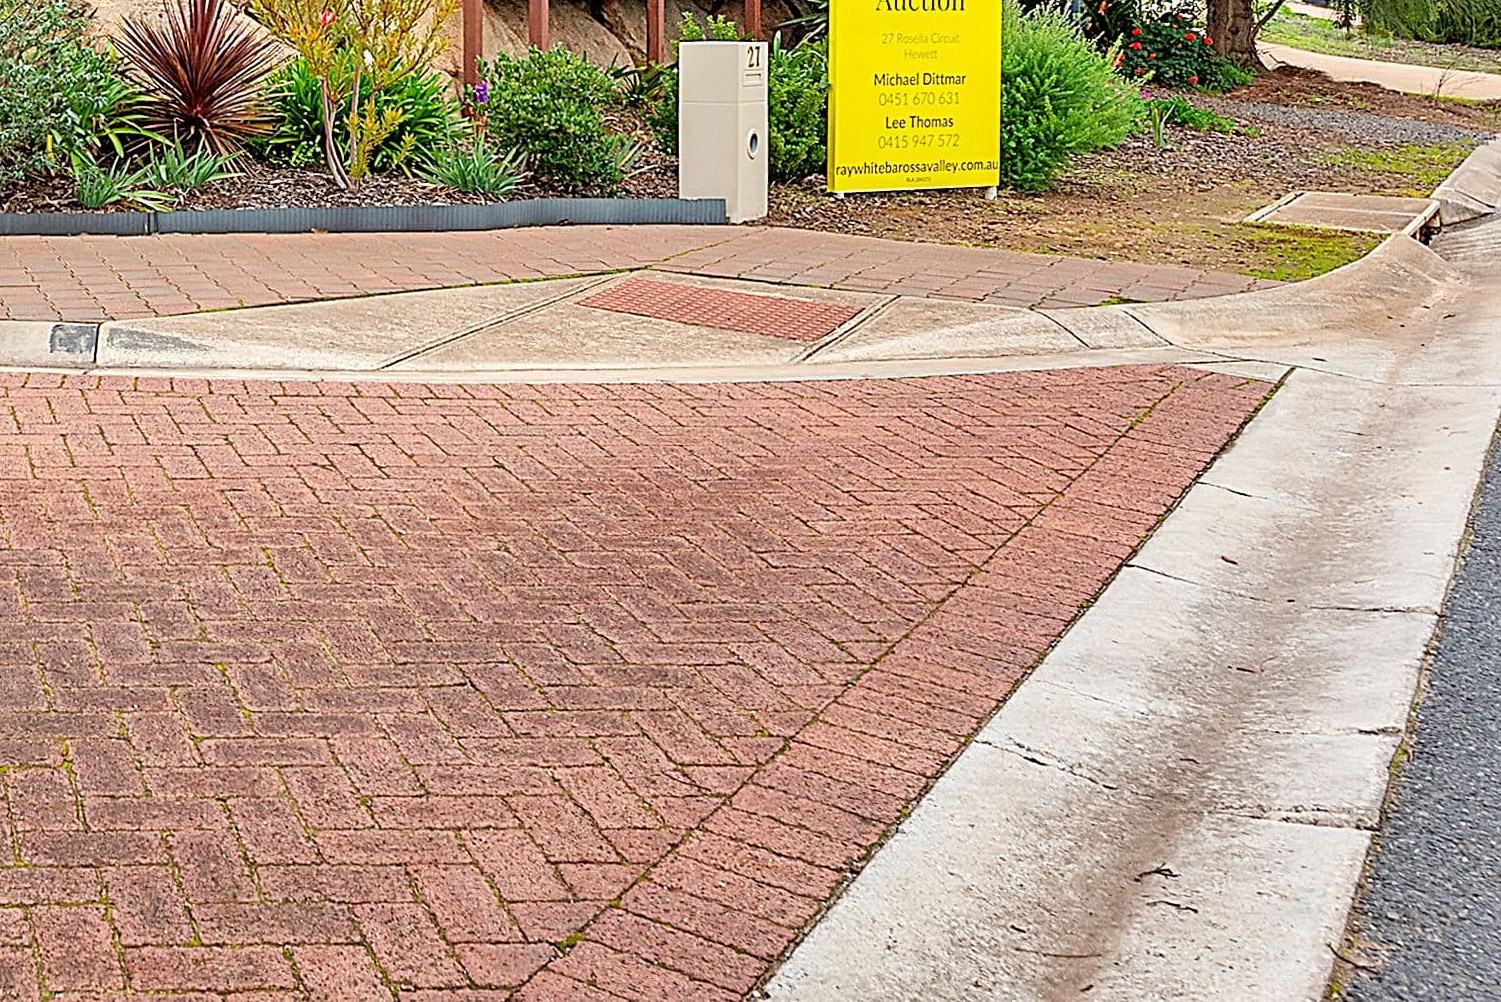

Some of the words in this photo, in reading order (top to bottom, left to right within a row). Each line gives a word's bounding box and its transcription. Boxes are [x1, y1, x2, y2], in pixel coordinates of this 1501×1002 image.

[882, 32, 894, 44] 27
[897, 32, 929, 44] Rosella
[931, 32, 960, 44] Circuit
[747, 46, 761, 68] 27
[904, 48, 938, 60] Hewett
[874, 73, 919, 86] Michael
[923, 72, 966, 86] Dittmar
[879, 92, 908, 106] 0451
[913, 92, 935, 105] 670
[939, 92, 960, 105] 631
[886, 116, 906, 129] Lee
[910, 115, 954, 129] Thomas
[878, 135, 908, 149] 0415
[912, 135, 934, 148] 947
[939, 134, 960, 147] 572
[836, 159, 998, 178] raywhitebarossavalley.com.au
